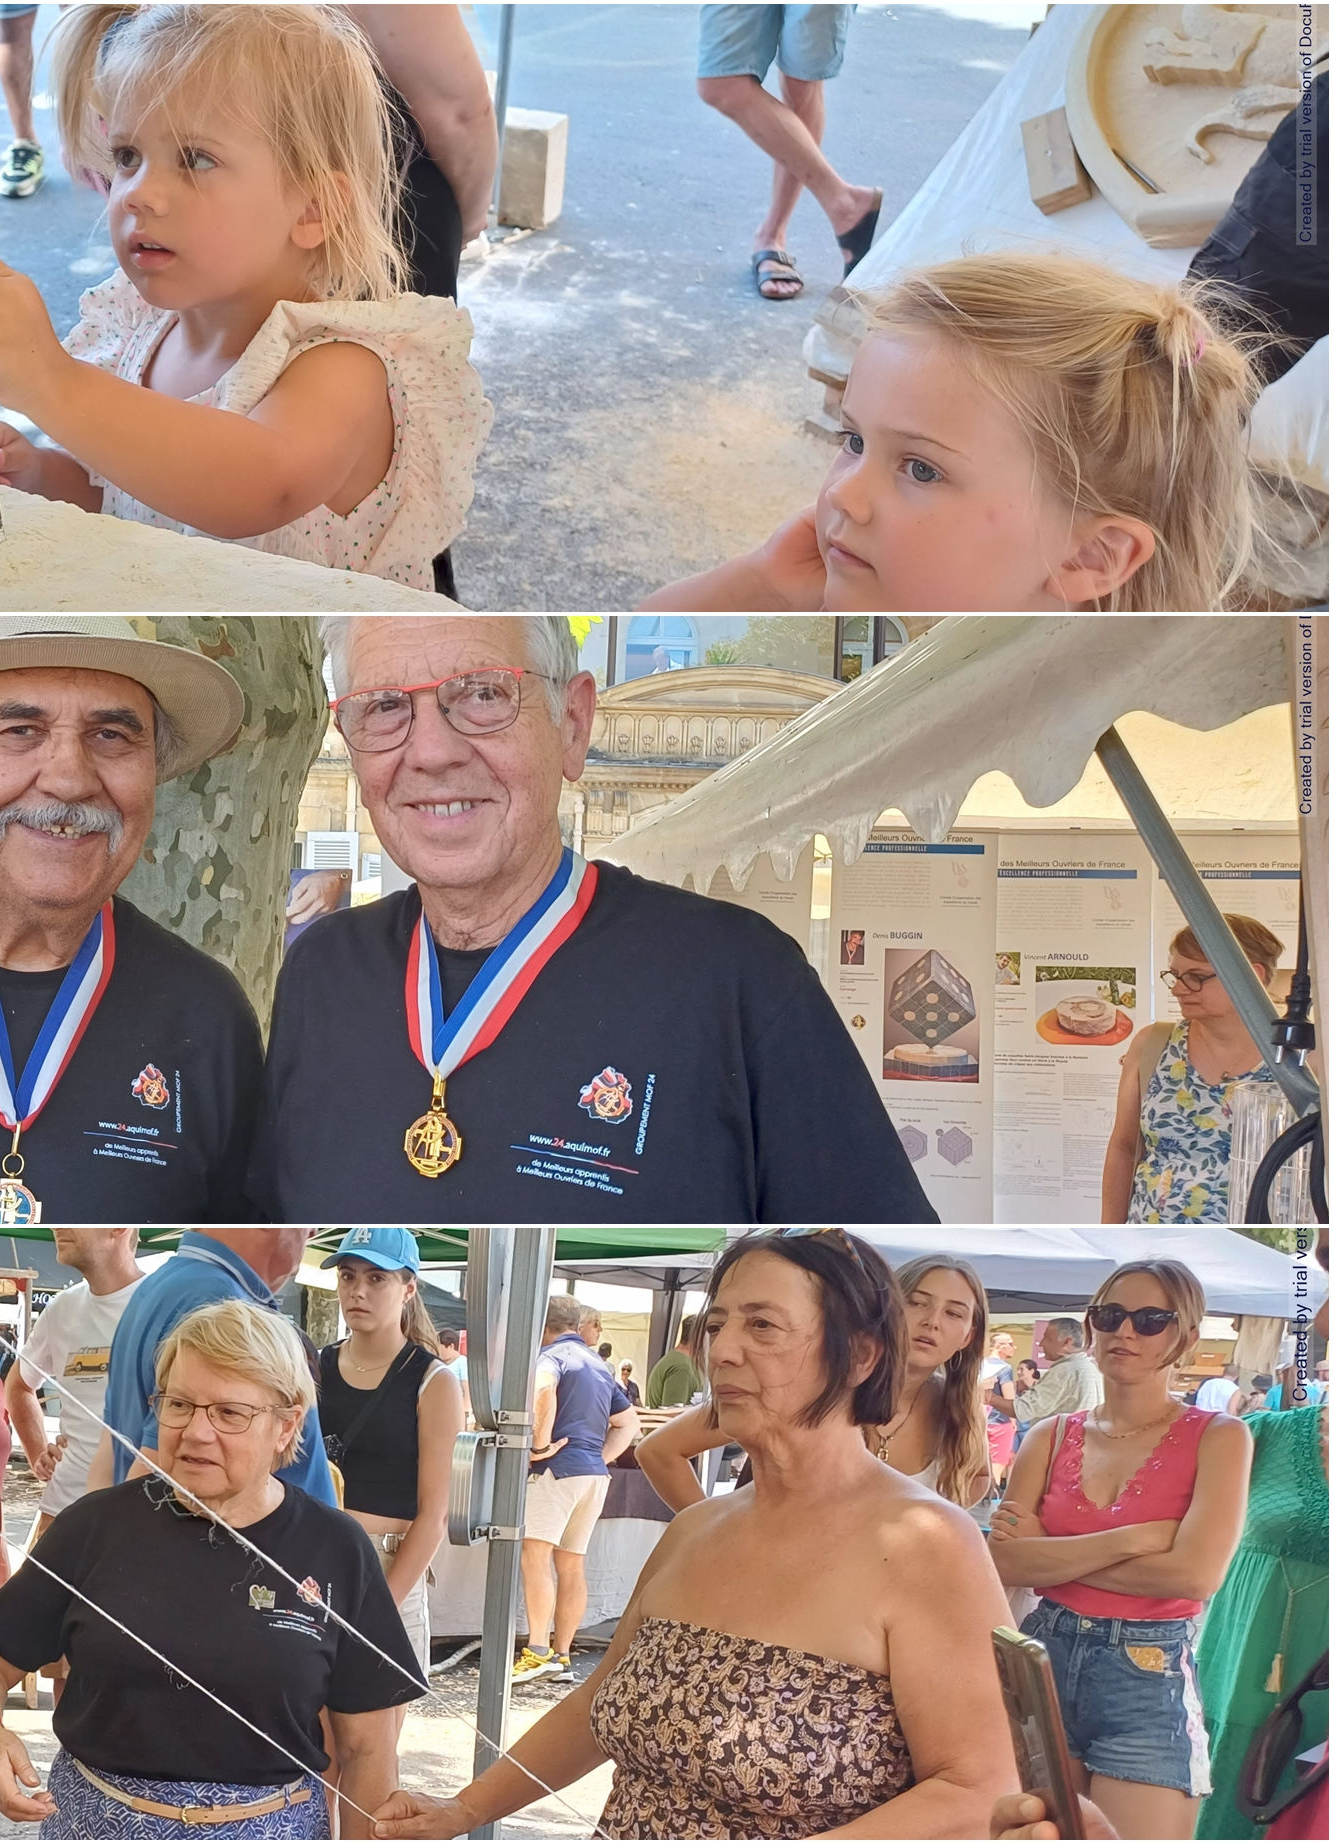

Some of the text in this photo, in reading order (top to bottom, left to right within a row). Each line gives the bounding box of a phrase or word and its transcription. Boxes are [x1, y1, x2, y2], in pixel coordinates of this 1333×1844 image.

[947, 834, 973, 843] France
[1000, 860, 1013, 868] des
[1016, 860, 1050, 868] Meilleurs
[1052, 860, 1085, 868] Ouvriers
[1099, 861, 1125, 869] France
[1224, 861, 1299, 869] Ouvriers de France
[1033, 870, 1079, 878] PROFESSIONNELLE
[872, 932, 923, 940] Denis BUGGIN
[1047, 953, 1089, 961] ARNOULD
[635, 1074, 655, 1155] GROUPEMENT MOF 24
[99, 1121, 159, 1136] www.24.aquimof.fr
[529, 1134, 611, 1157] www.24.aquimof.fr
[531, 1159, 610, 1182] de Meilleurs apprentis
[522, 1166, 624, 1194] Meilleurs Ouvriers de France
